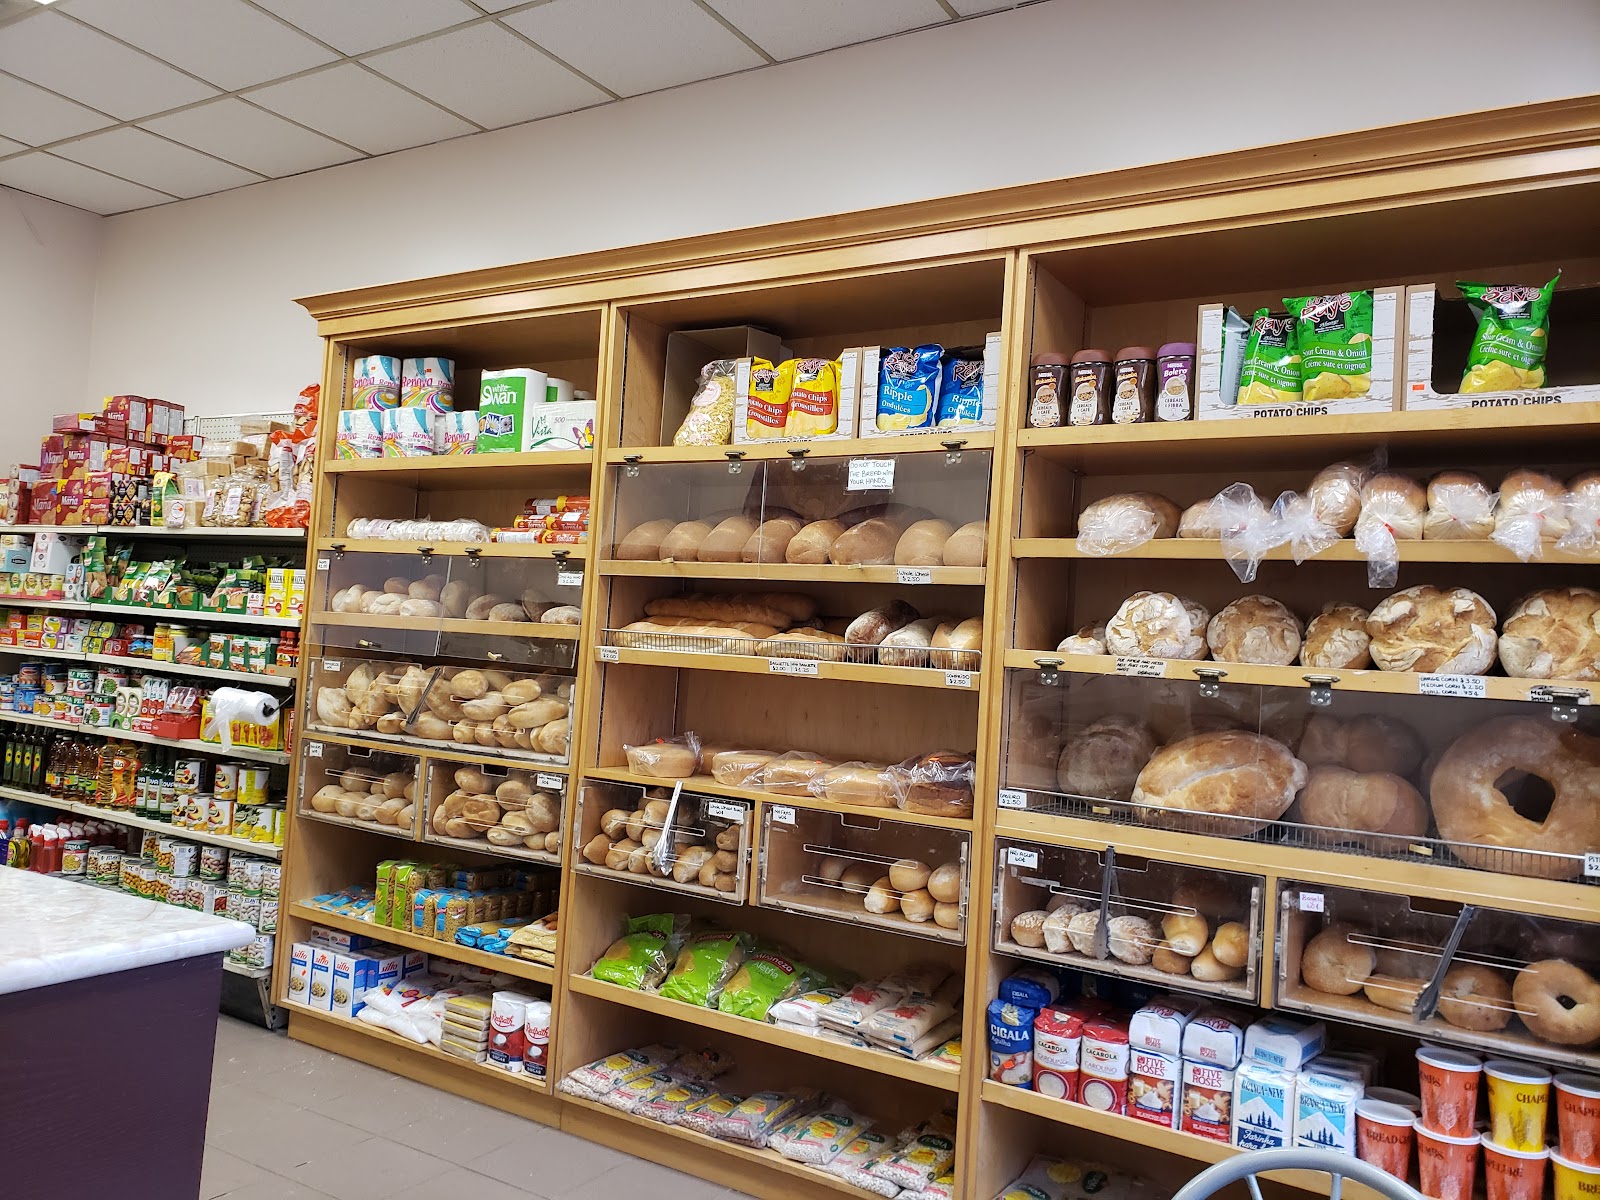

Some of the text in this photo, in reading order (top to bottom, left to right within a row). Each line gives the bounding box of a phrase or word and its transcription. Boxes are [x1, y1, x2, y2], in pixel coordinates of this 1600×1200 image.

[1517, 339, 1524, 349] &
[1315, 346, 1336, 357] Cream
[1338, 350, 1345, 358] &
[1345, 349, 1366, 358] Onion
[1498, 348, 1512, 359] sure
[1513, 353, 1520, 361] et
[1163, 367, 1188, 378] Bolero
[1254, 356, 1273, 369] Cream
[1273, 364, 1280, 372] &
[1280, 365, 1300, 377] Onion
[1322, 361, 1336, 369] sure
[1336, 361, 1344, 369] et
[1344, 362, 1366, 371] oignon
[402, 375, 433, 388] Renova
[492, 382, 511, 393] white
[1276, 378, 1297, 390] oignon
[480, 385, 518, 406] Swan
[807, 392, 828, 404] Chips
[883, 385, 913, 402] Ripple
[881, 399, 911, 414] Ondulées
[1472, 395, 1562, 409] POTATO CHIPS
[763, 404, 783, 417] Chips
[1254, 406, 1328, 419] POTATO CHIPS
[553, 416, 566, 424] 500
[68, 449, 85, 461] Maria
[861, 470, 882, 478] BREAD
[865, 476, 887, 485] HANDS
[61, 494, 79, 506] Maria
[381, 960, 398, 973] sifto
[753, 962, 780, 980] Aletria
[1011, 990, 1029, 999] CIGALA
[492, 1010, 515, 1027] Redpath
[526, 1022, 550, 1038] Redpath
[990, 1023, 1030, 1041] CIGALA
[1084, 1060, 1118, 1074] CAROLINO
[1145, 1057, 1166, 1069] FIVE
[1136, 1063, 1165, 1077] ROSES
[1201, 1069, 1222, 1080] FIVE
[1192, 1075, 1222, 1088] ROSES
[1241, 1078, 1285, 1099] BRANCA-NEVE
[1366, 1128, 1398, 1144] BREAD
